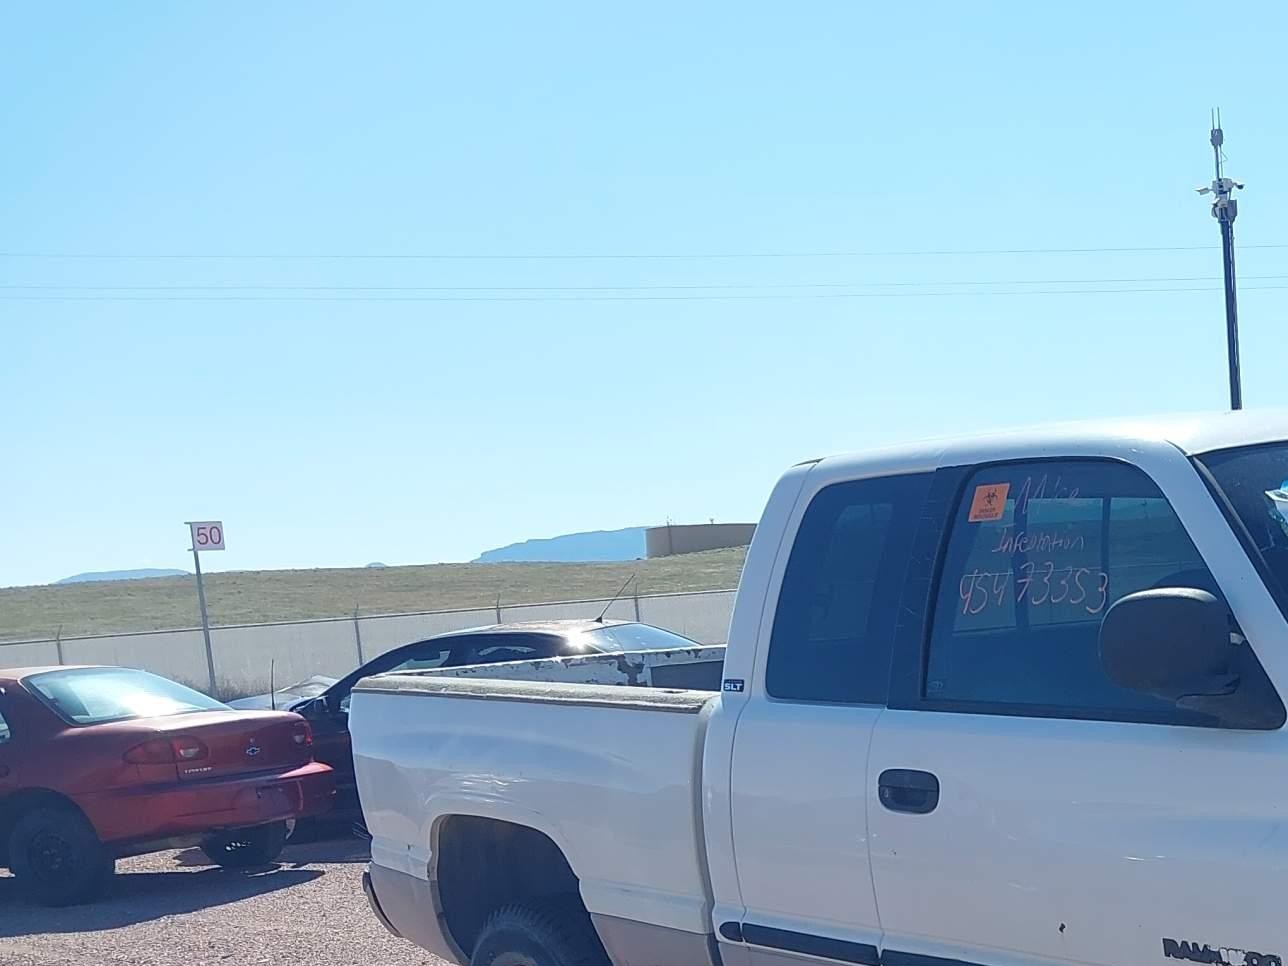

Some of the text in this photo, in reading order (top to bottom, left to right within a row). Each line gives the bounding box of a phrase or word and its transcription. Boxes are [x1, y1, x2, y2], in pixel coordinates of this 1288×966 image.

[197, 526, 222, 545] 50
[960, 561, 1108, 615] 45473353
[724, 682, 743, 690] SLT
